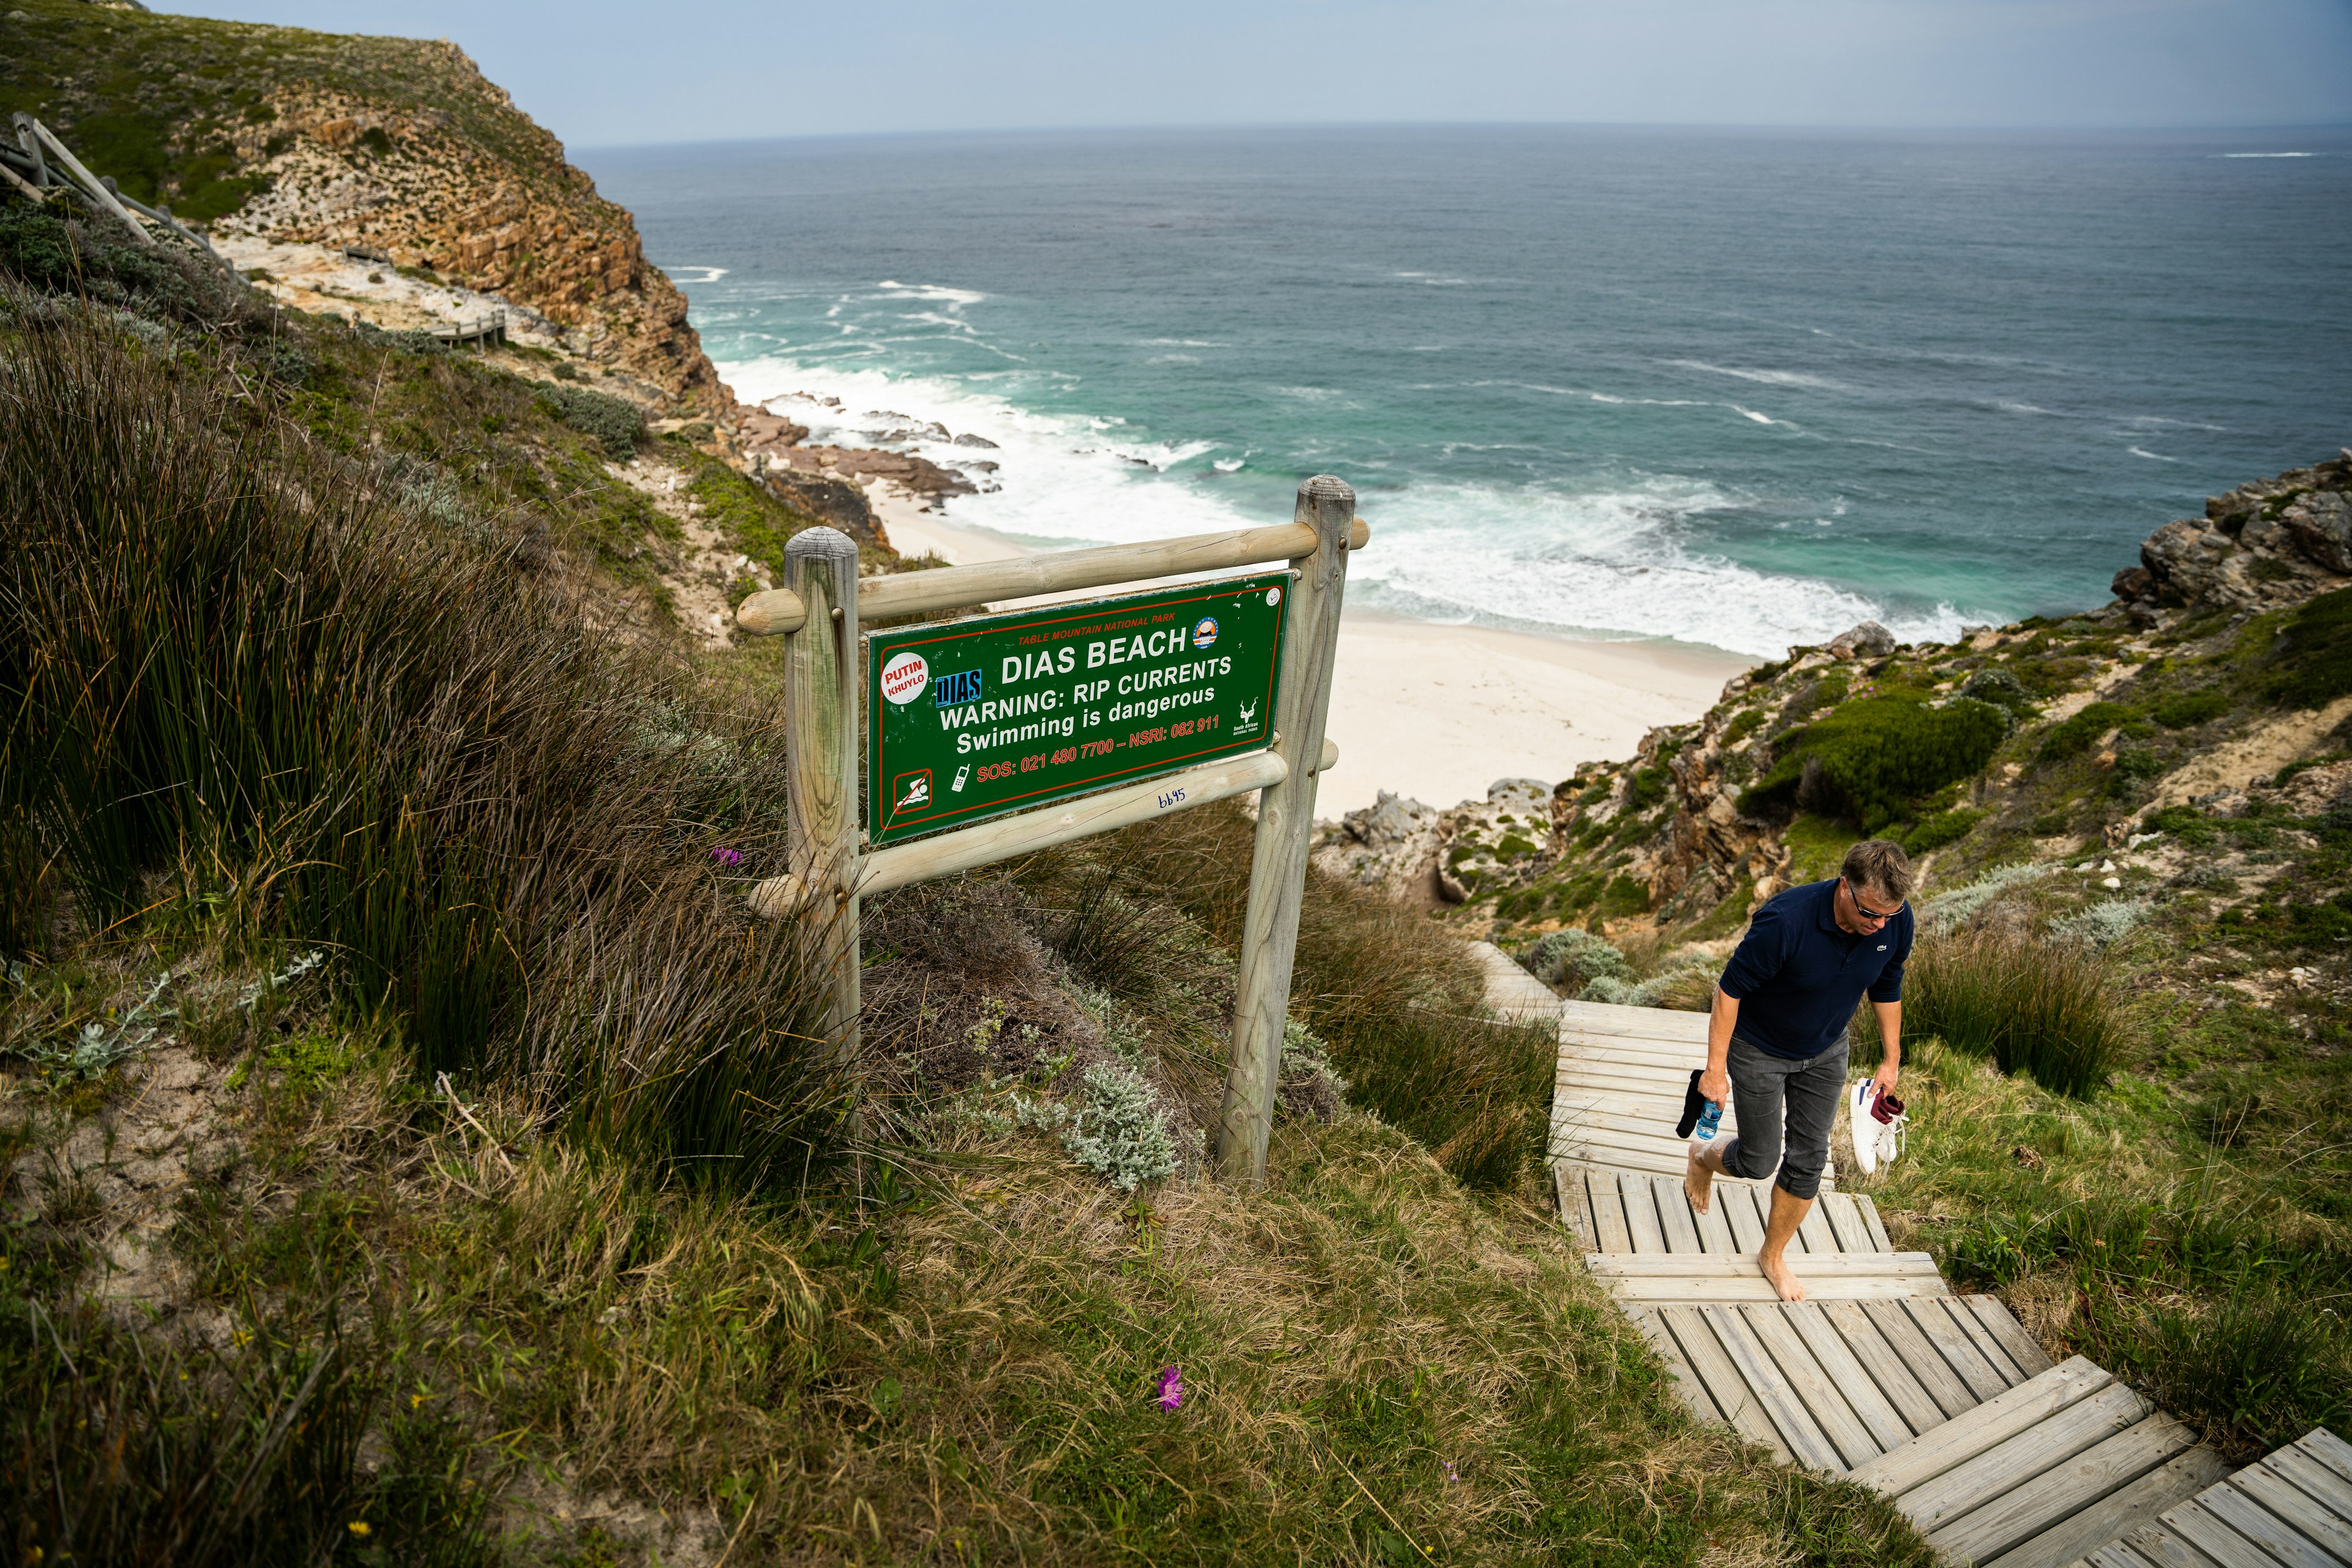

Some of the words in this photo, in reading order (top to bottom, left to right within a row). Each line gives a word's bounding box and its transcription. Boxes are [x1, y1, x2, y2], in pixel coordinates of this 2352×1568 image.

[1019, 633, 1049, 646] TABLE
[1052, 625, 1102, 640] MOUNTAIN
[1104, 617, 1147, 631] NATIONAL
[1151, 612, 1175, 624] PARK
[884, 660, 922, 685] PUTIN
[1002, 647, 1075, 684] DIAS
[1088, 627, 1186, 668] BEACH
[888, 674, 924, 697] KHUYLO
[938, 671, 980, 706] DIAS
[940, 690, 1063, 730] WARNING:
[1074, 680, 1110, 704] RIP
[1118, 657, 1231, 695] CURRENTS
[957, 717, 1074, 753] Swimming
[1084, 709, 1100, 727] is
[1109, 688, 1214, 722] dangerous
[977, 761, 1016, 782] SOS:
[1021, 753, 1046, 772] 021
[1050, 747, 1077, 765] 480
[1081, 739, 1114, 758] 7700
[1129, 727, 1167, 747] NSRI:
[1170, 720, 1194, 738] 082
[1197, 715, 1218, 732] 911
